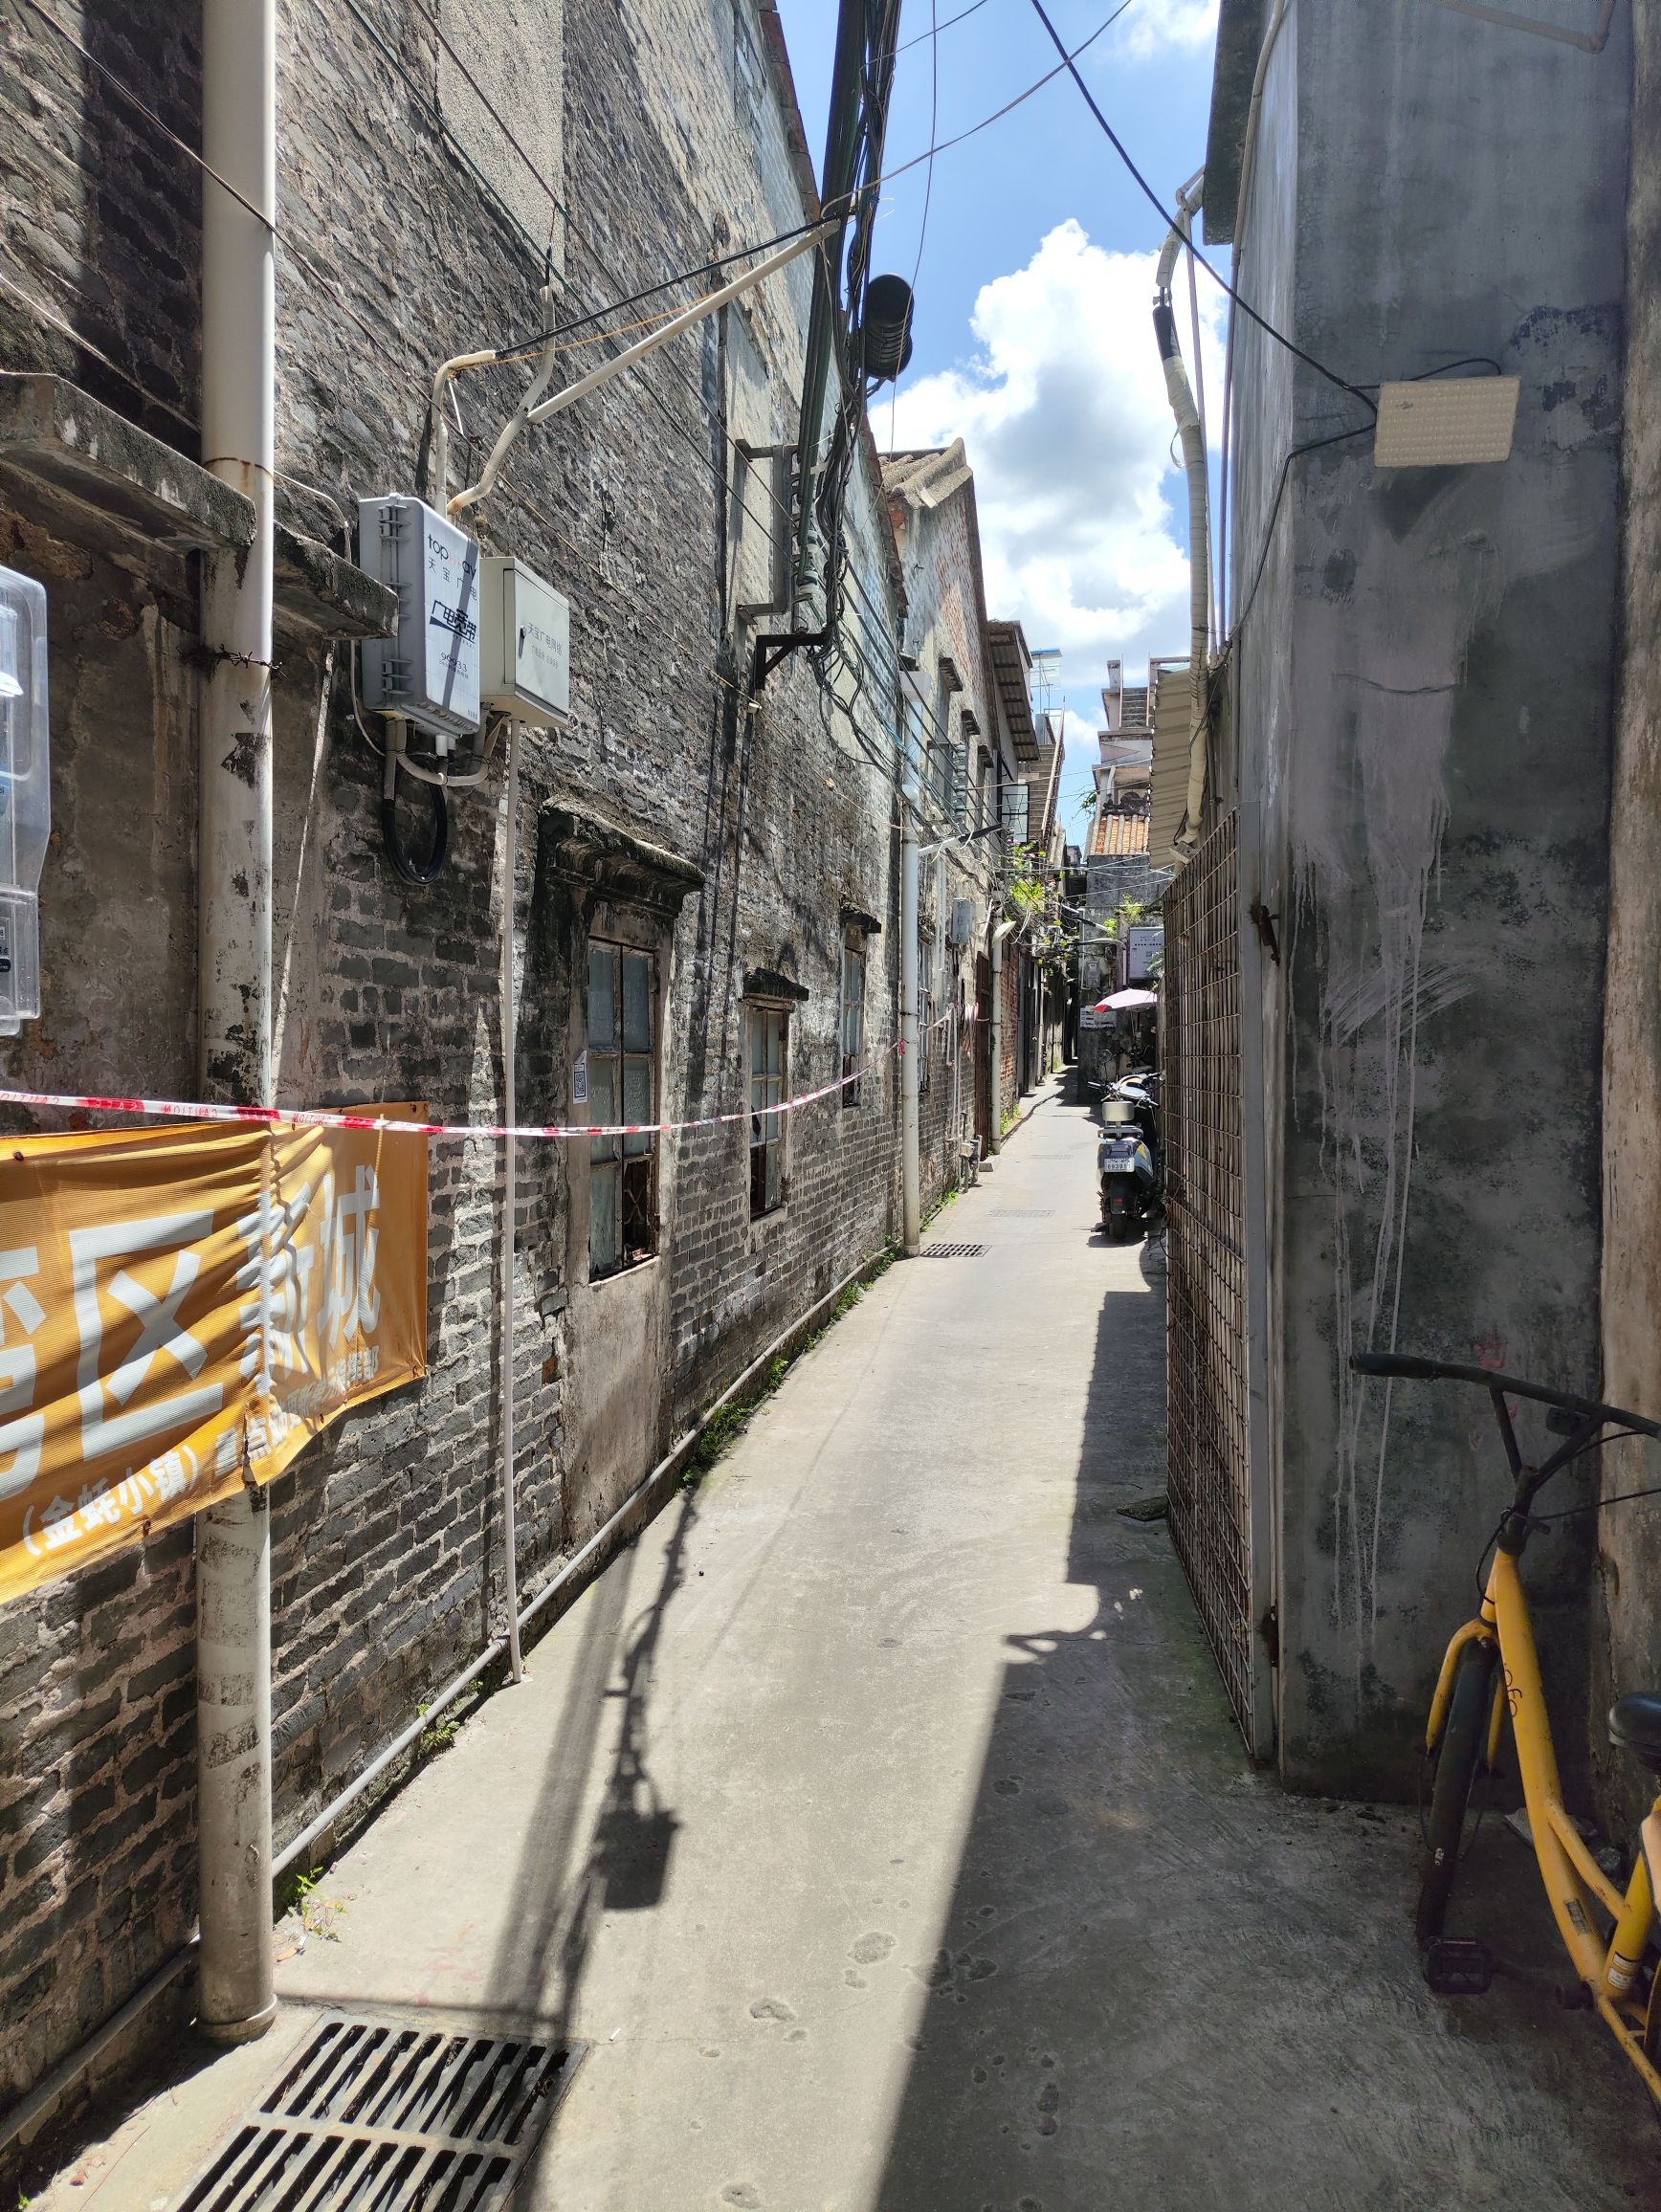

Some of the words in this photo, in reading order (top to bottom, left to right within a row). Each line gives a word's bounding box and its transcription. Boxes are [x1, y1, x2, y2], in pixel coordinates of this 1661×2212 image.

[428, 556, 477, 602] 天宝广电
[431, 599, 477, 641] 广电宽带
